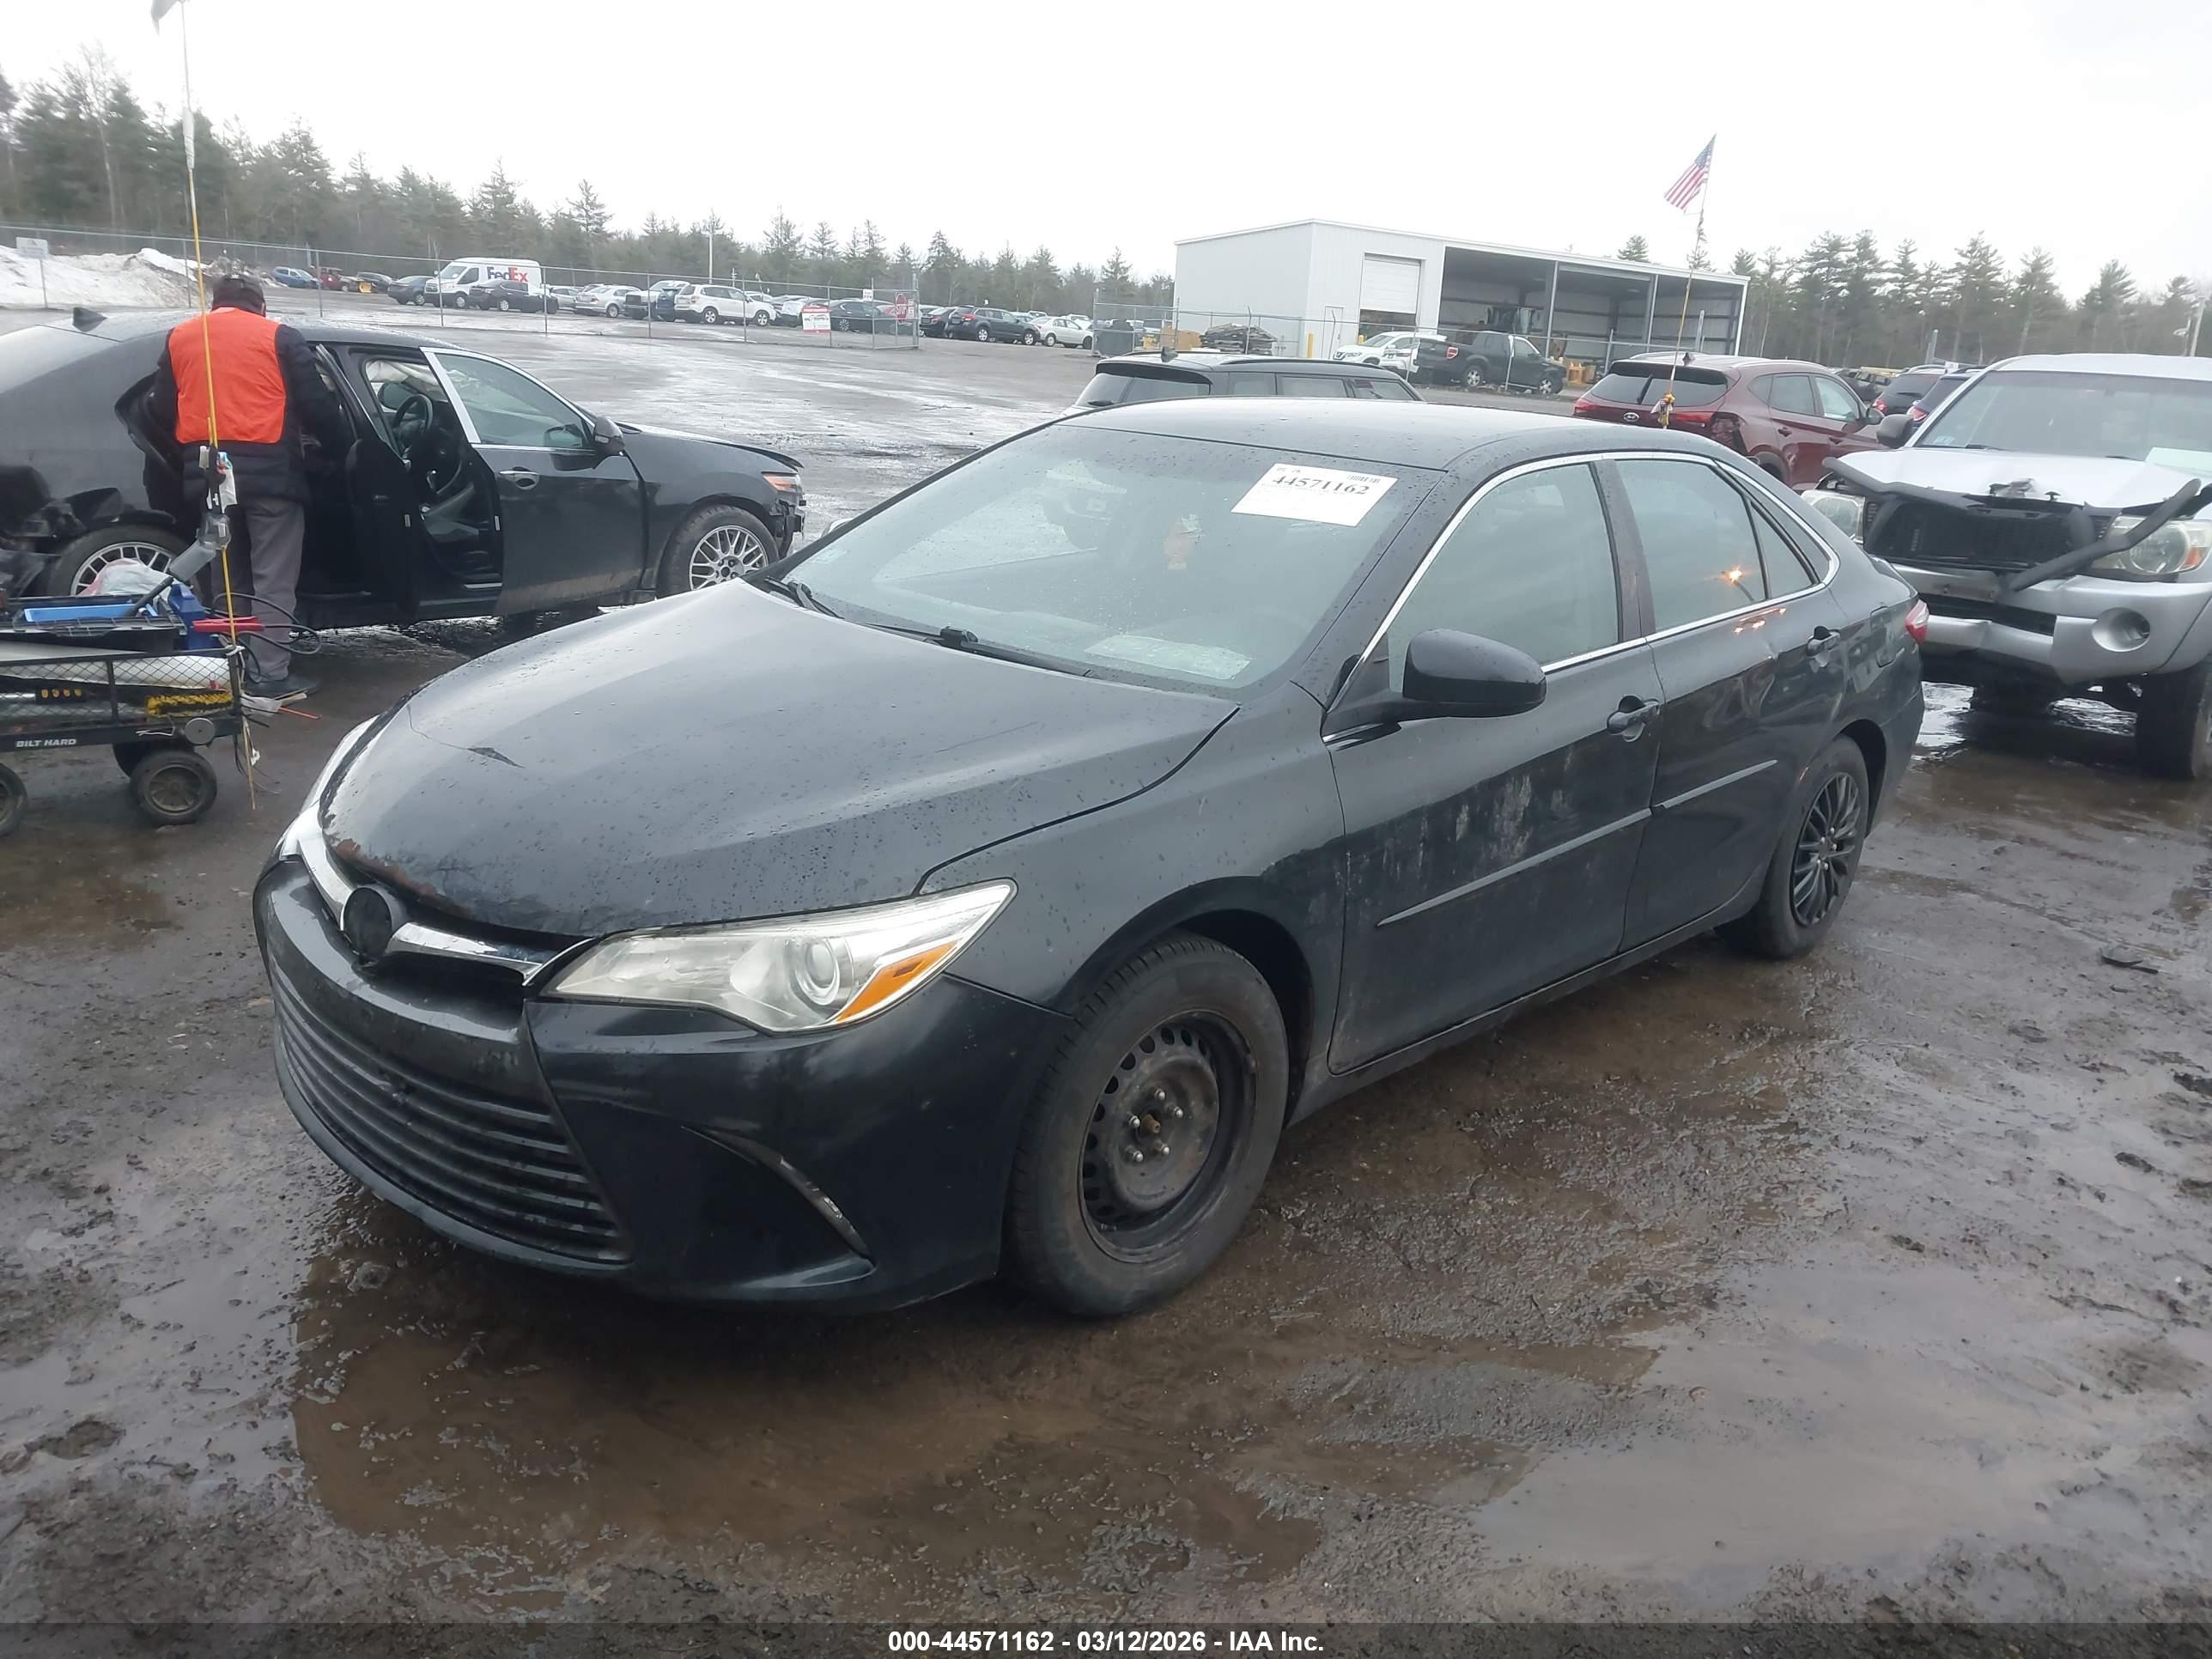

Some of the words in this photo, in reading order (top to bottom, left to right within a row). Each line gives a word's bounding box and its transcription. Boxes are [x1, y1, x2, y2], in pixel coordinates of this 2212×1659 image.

[487, 266, 529, 283] FedEx
[896, 303, 907, 315] STOP
[1272, 475, 1370, 495] 44571162
[16, 739, 42, 748] BILT
